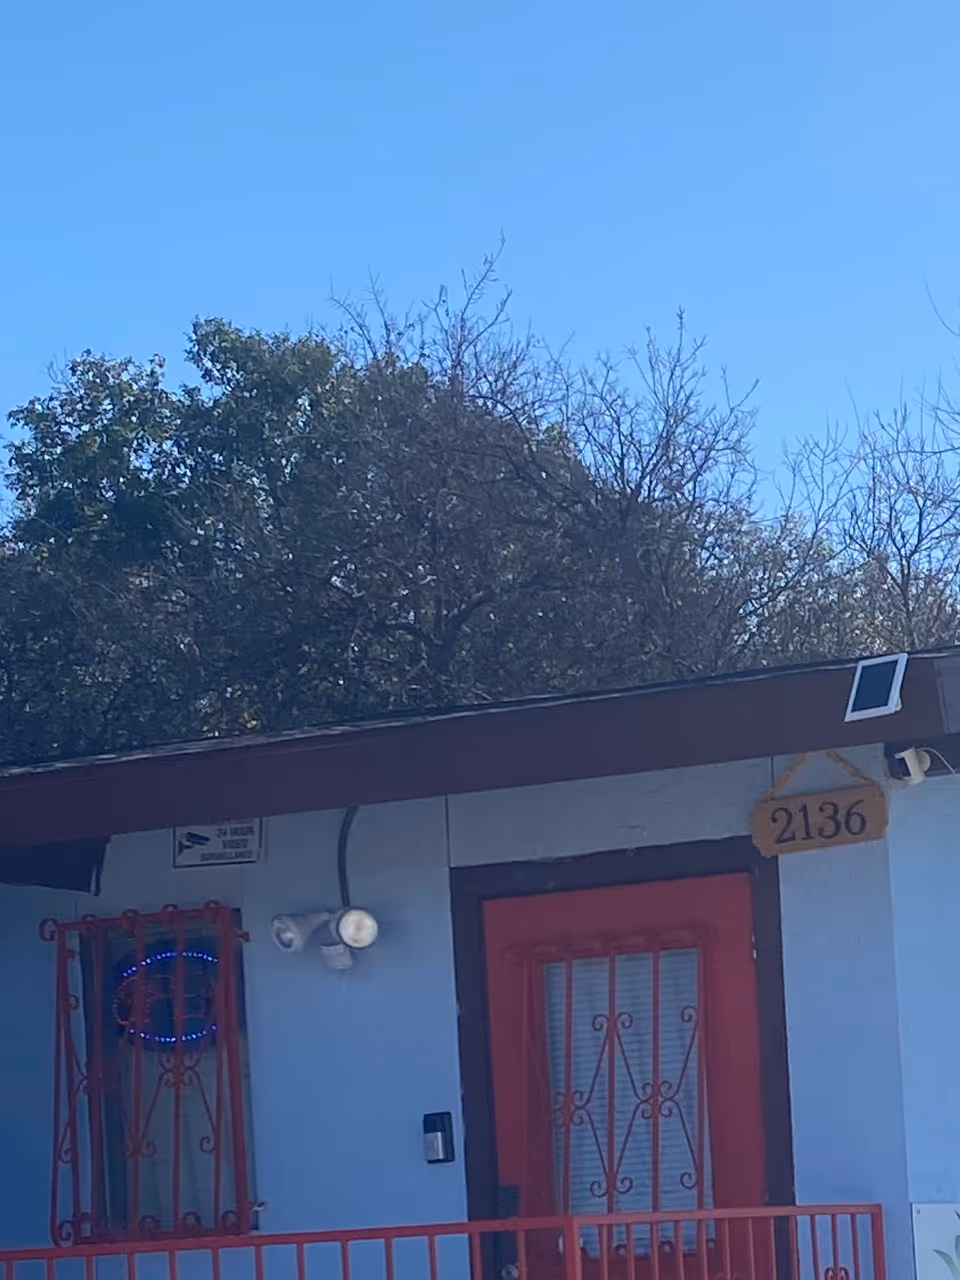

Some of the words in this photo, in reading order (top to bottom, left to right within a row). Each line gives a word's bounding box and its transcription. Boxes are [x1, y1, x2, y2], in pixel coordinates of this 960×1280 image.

[770, 799, 867, 845] 2136
[217, 827, 227, 839] 24
[229, 825, 255, 837] HOUR
[222, 838, 249, 849] VIDEO
